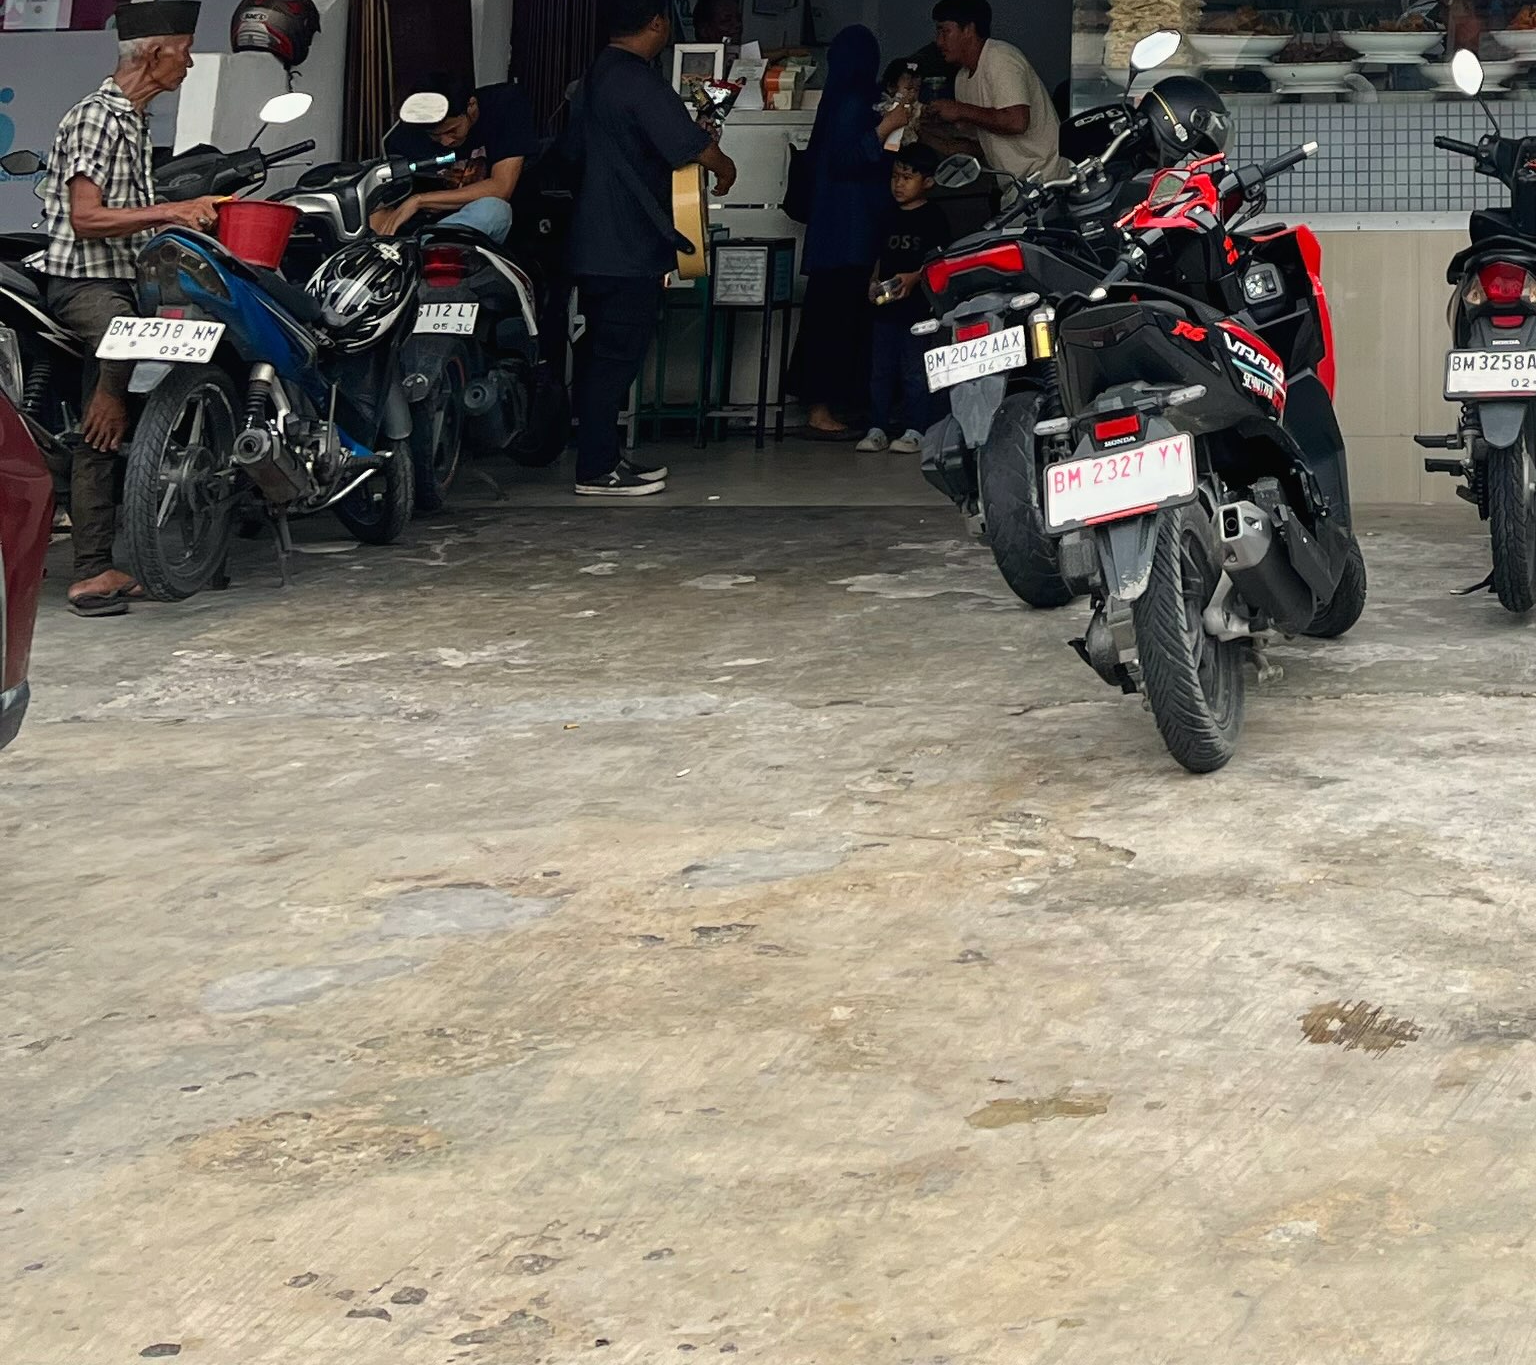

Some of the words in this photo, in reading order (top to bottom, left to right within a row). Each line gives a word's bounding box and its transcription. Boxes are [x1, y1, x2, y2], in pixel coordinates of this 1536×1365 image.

[458, 304, 477, 318] LT
[109, 320, 136, 337] BM
[138, 321, 184, 339] 2518
[191, 325, 219, 341] NM
[926, 350, 946, 372] BM
[951, 340, 988, 365] 2042
[991, 330, 1021, 353] AAX
[1452, 356, 1476, 372] BM
[1103, 435, 1137, 448] HONDA
[1054, 466, 1082, 494] BM
[1093, 451, 1145, 486] 2327
[1158, 441, 1184, 468] YY
